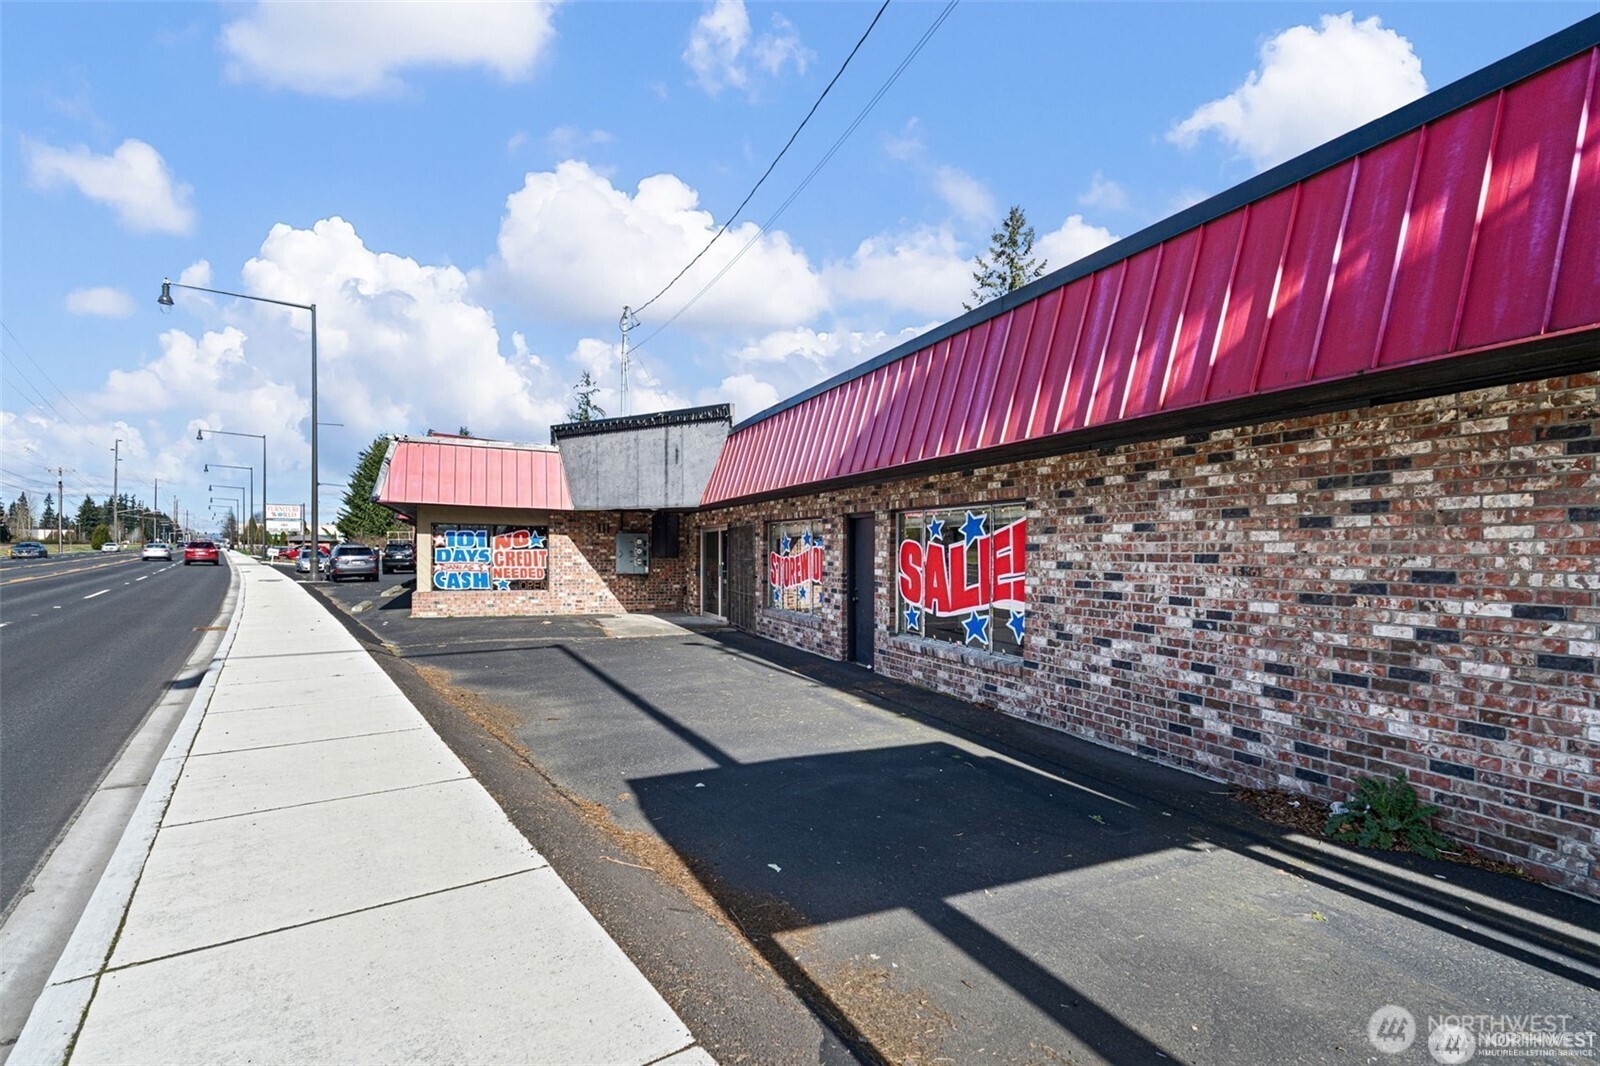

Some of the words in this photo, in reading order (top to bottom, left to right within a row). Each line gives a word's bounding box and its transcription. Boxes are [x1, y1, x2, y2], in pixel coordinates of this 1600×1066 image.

[445, 530, 488, 548] 101
[493, 530, 530, 550] NO
[436, 549, 490, 563] DAYS
[493, 550, 547, 567] CREDIT
[434, 571, 490, 589] CASH
[493, 567, 545, 579] NEEDED
